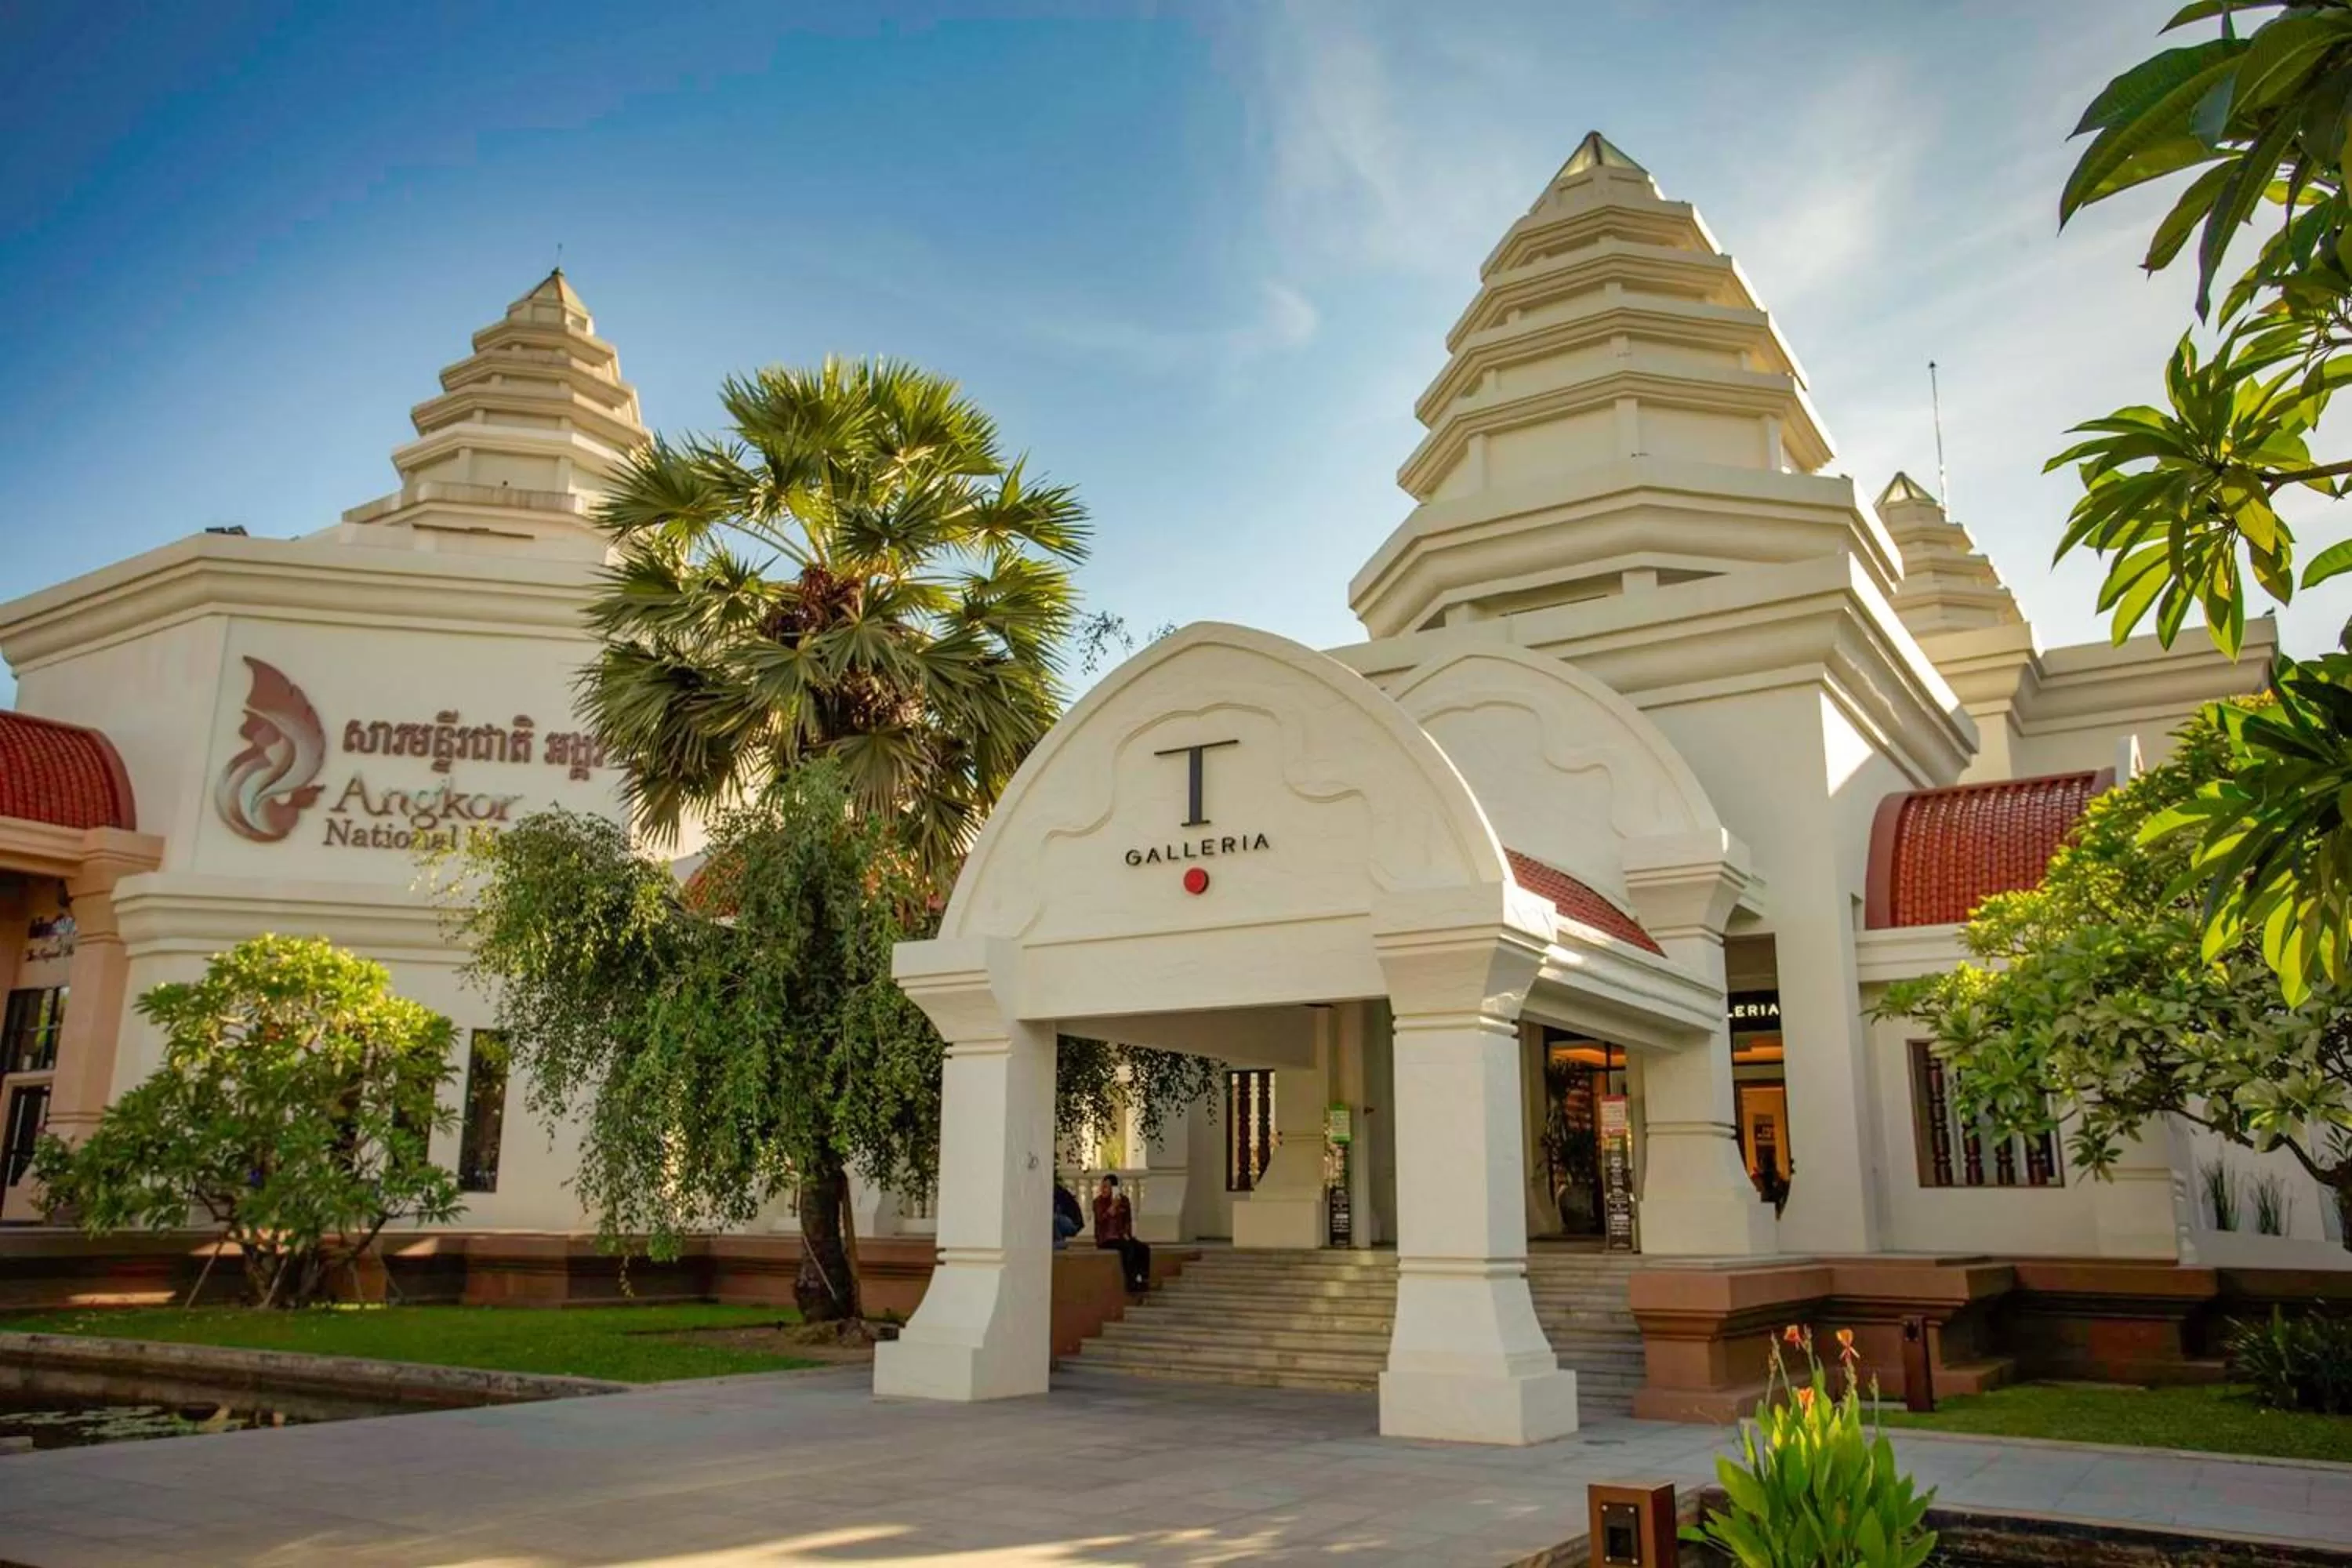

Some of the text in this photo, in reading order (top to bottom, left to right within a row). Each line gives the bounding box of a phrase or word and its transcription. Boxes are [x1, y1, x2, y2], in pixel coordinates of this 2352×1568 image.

[328, 775, 524, 830] Angkor
[1154, 739, 1240, 827] T
[1125, 833, 1270, 866] GALLERIA
[1726, 1004, 1780, 1018] ERIA
